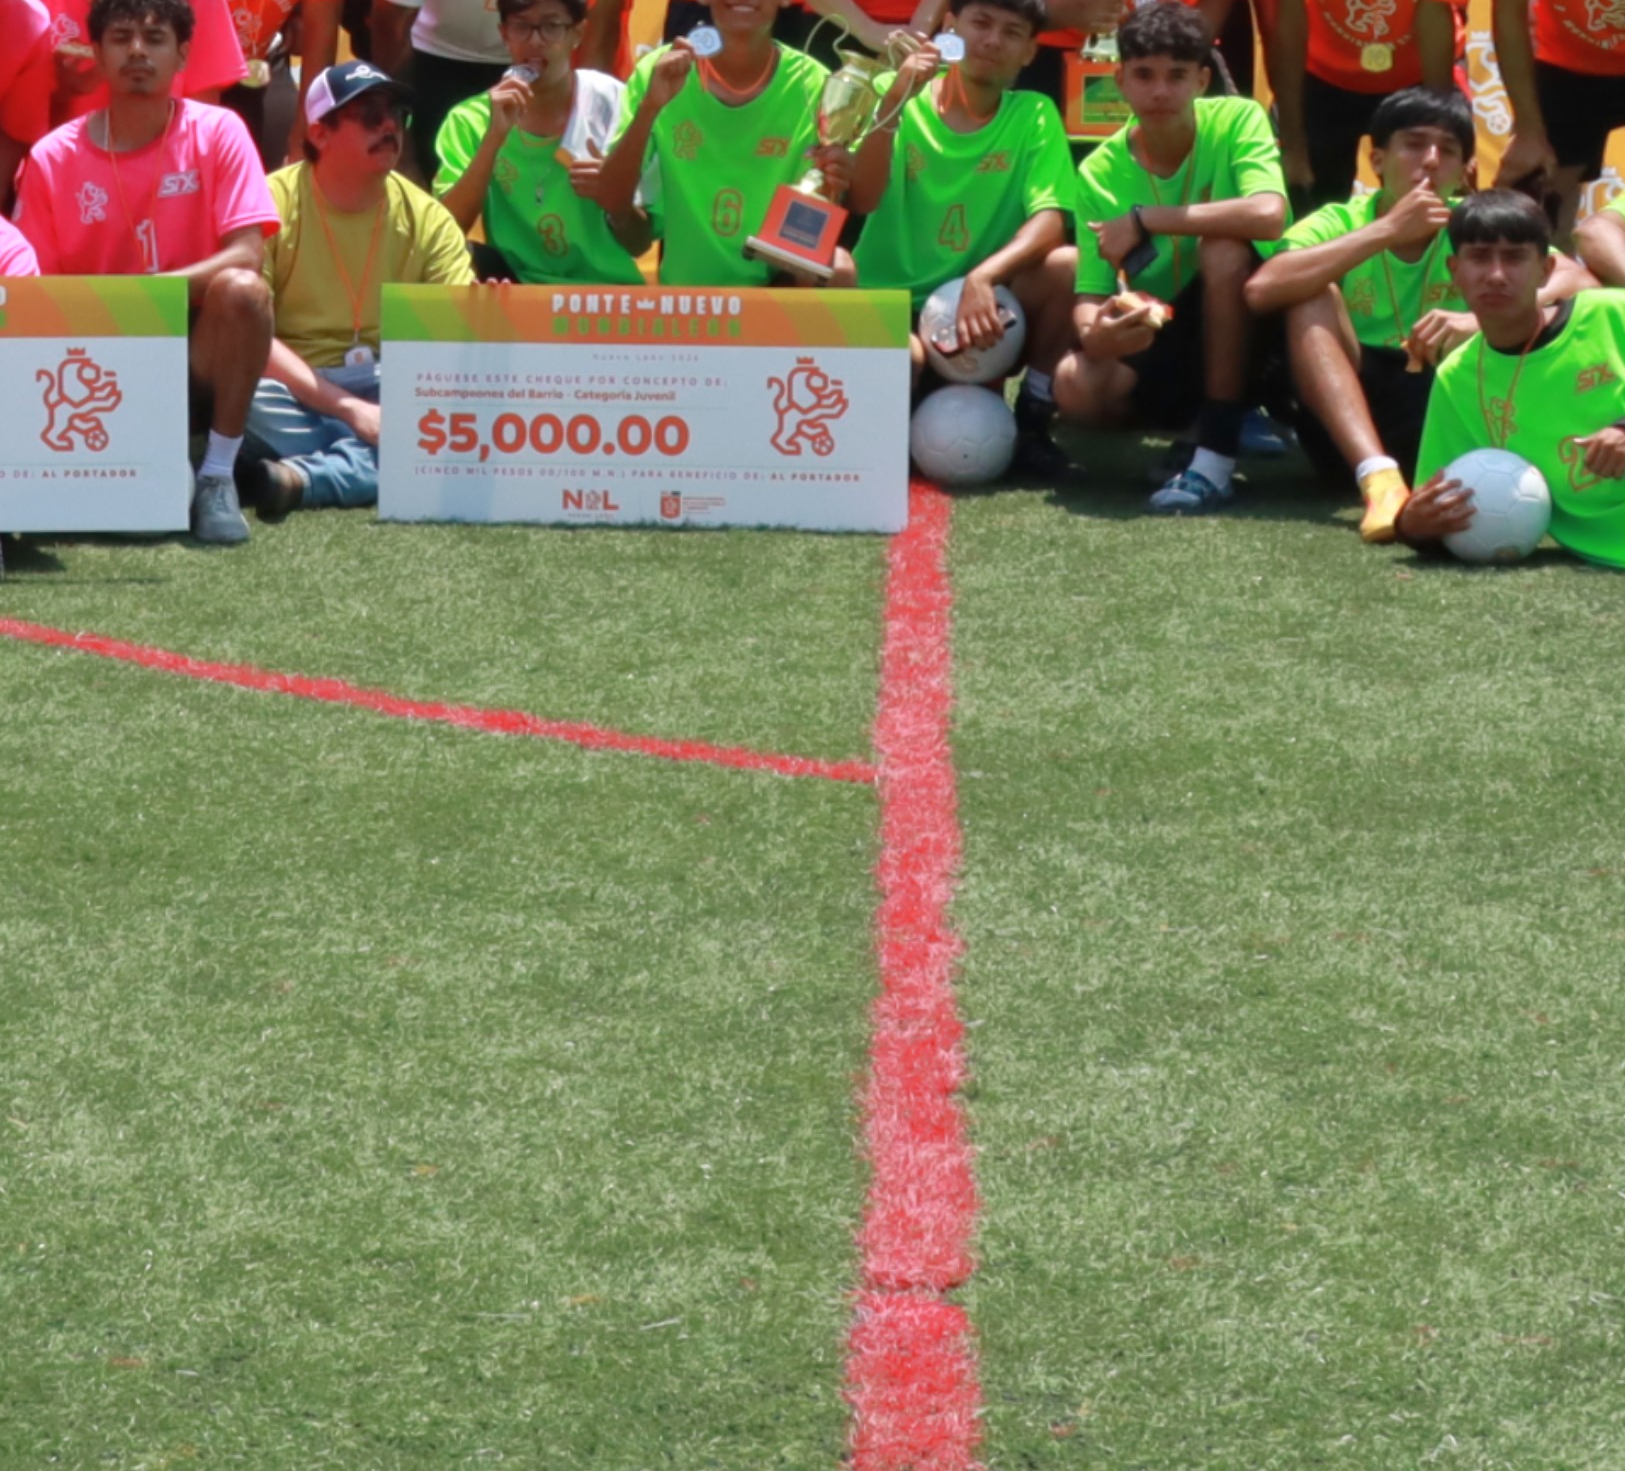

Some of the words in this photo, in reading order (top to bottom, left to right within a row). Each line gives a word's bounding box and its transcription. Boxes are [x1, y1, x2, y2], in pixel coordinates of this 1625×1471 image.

[712, 188, 744, 238] 6
[938, 204, 970, 252] 4
[551, 293, 630, 313] PONTE
[660, 295, 741, 315] NUEVO
[588, 375, 615, 384] POR
[507, 388, 525, 398] del
[528, 388, 563, 399] Barrio
[634, 390, 675, 400] Juvenil
[417, 408, 689, 466] $5,000.00
[41, 469, 56, 478] AL
[63, 469, 136, 478] PORTADOR
[770, 472, 784, 480] AL
